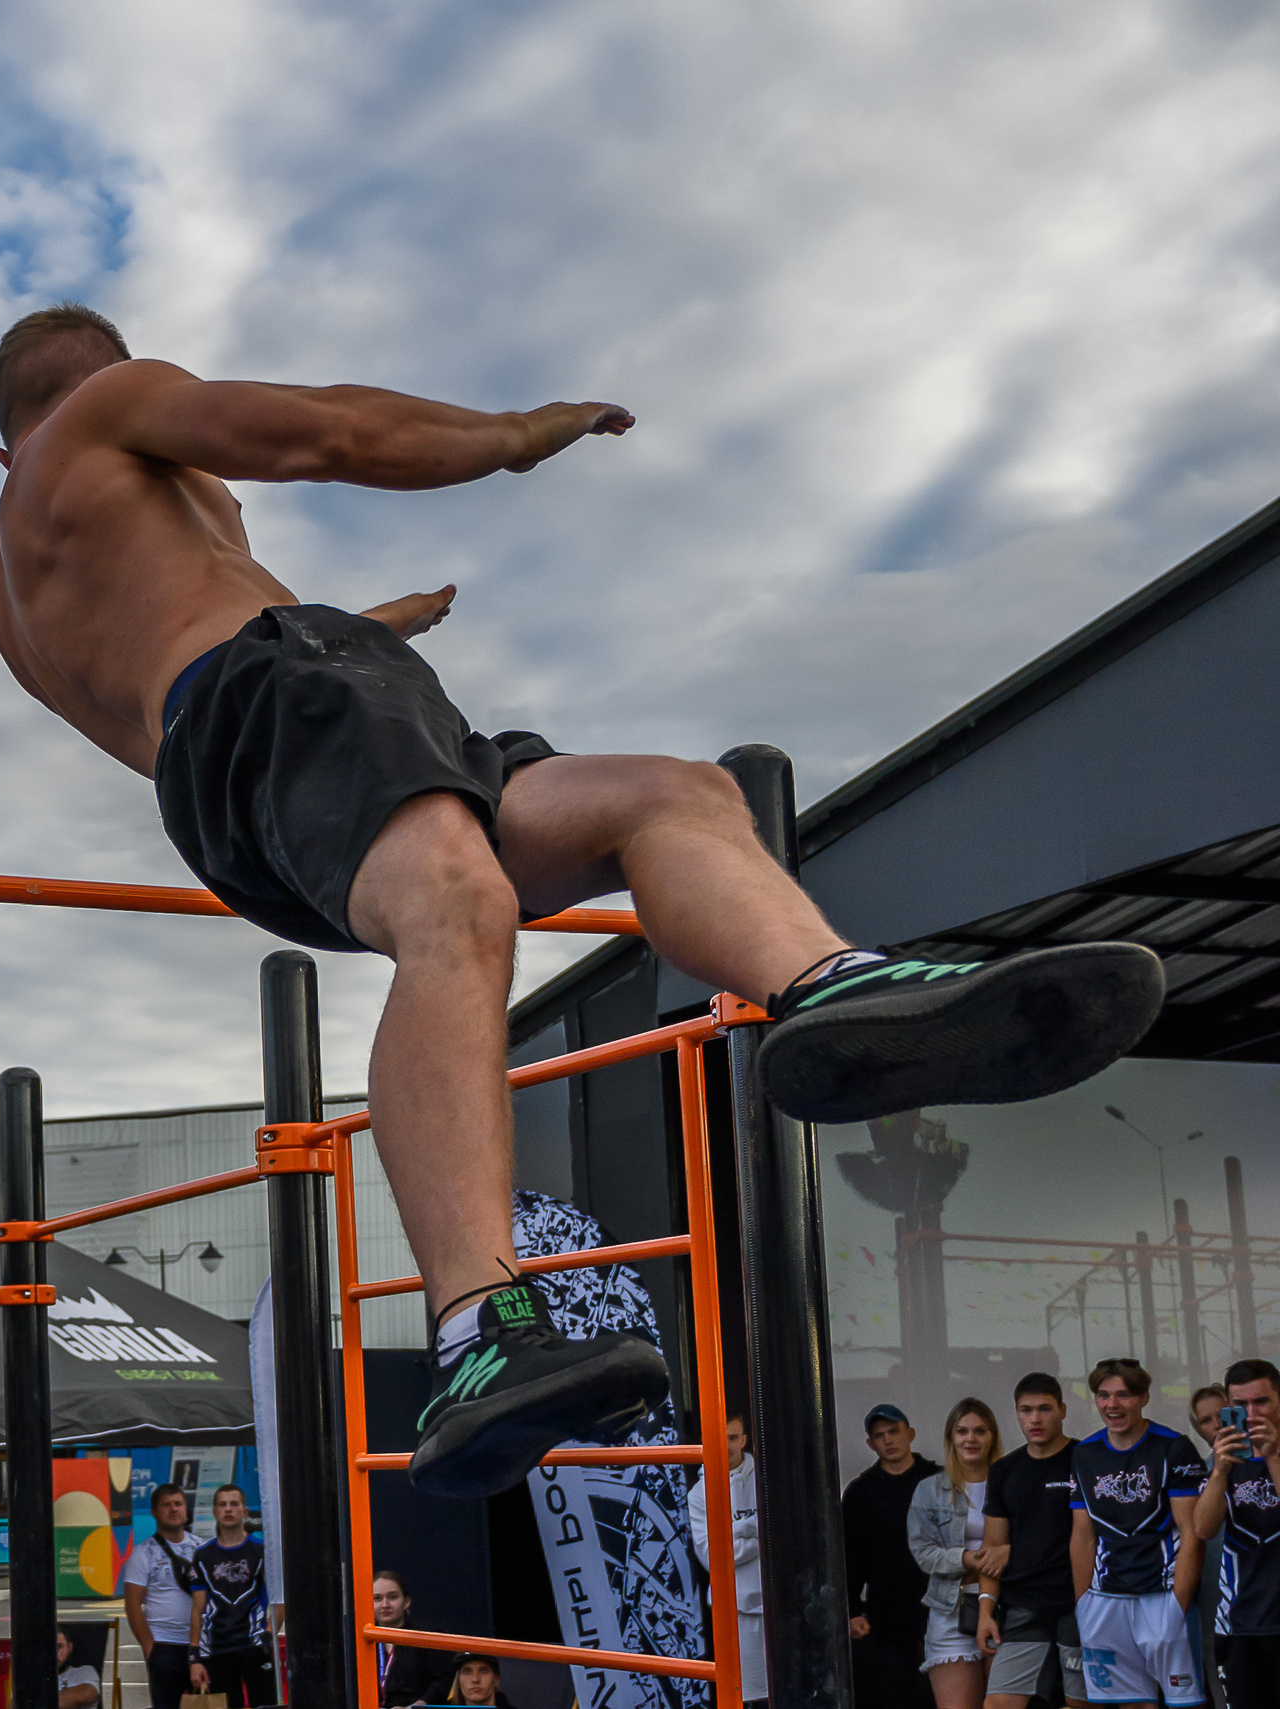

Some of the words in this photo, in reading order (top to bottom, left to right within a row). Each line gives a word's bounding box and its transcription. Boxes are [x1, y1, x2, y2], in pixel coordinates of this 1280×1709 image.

[490, 1286, 529, 1306] SAYT
[496, 1301, 536, 1321] RLAE
[47, 1323, 218, 1363] GORILLA
